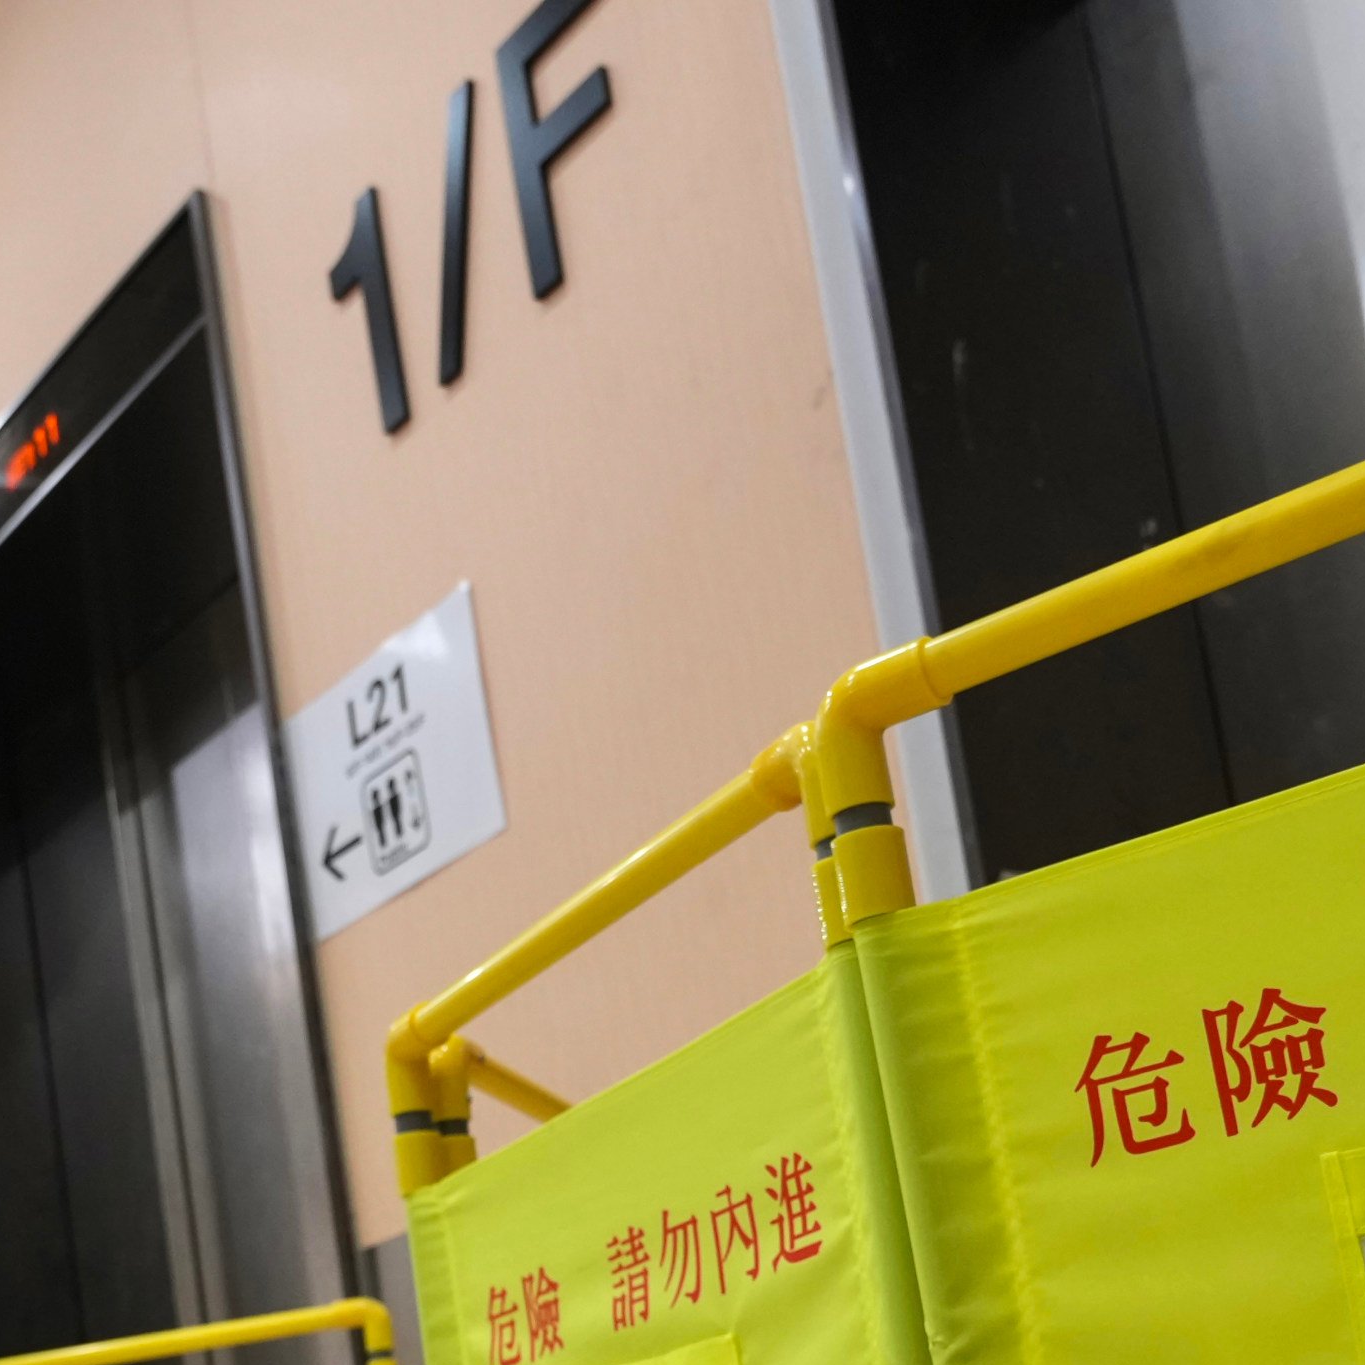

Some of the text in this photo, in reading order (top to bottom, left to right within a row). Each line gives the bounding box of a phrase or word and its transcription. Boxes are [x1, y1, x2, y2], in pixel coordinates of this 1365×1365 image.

[329, 0, 613, 435] 1/F
[346, 662, 409, 748] L21
[1073, 986, 1340, 1168] 危險
[607, 1152, 823, 1332] 請勿內進
